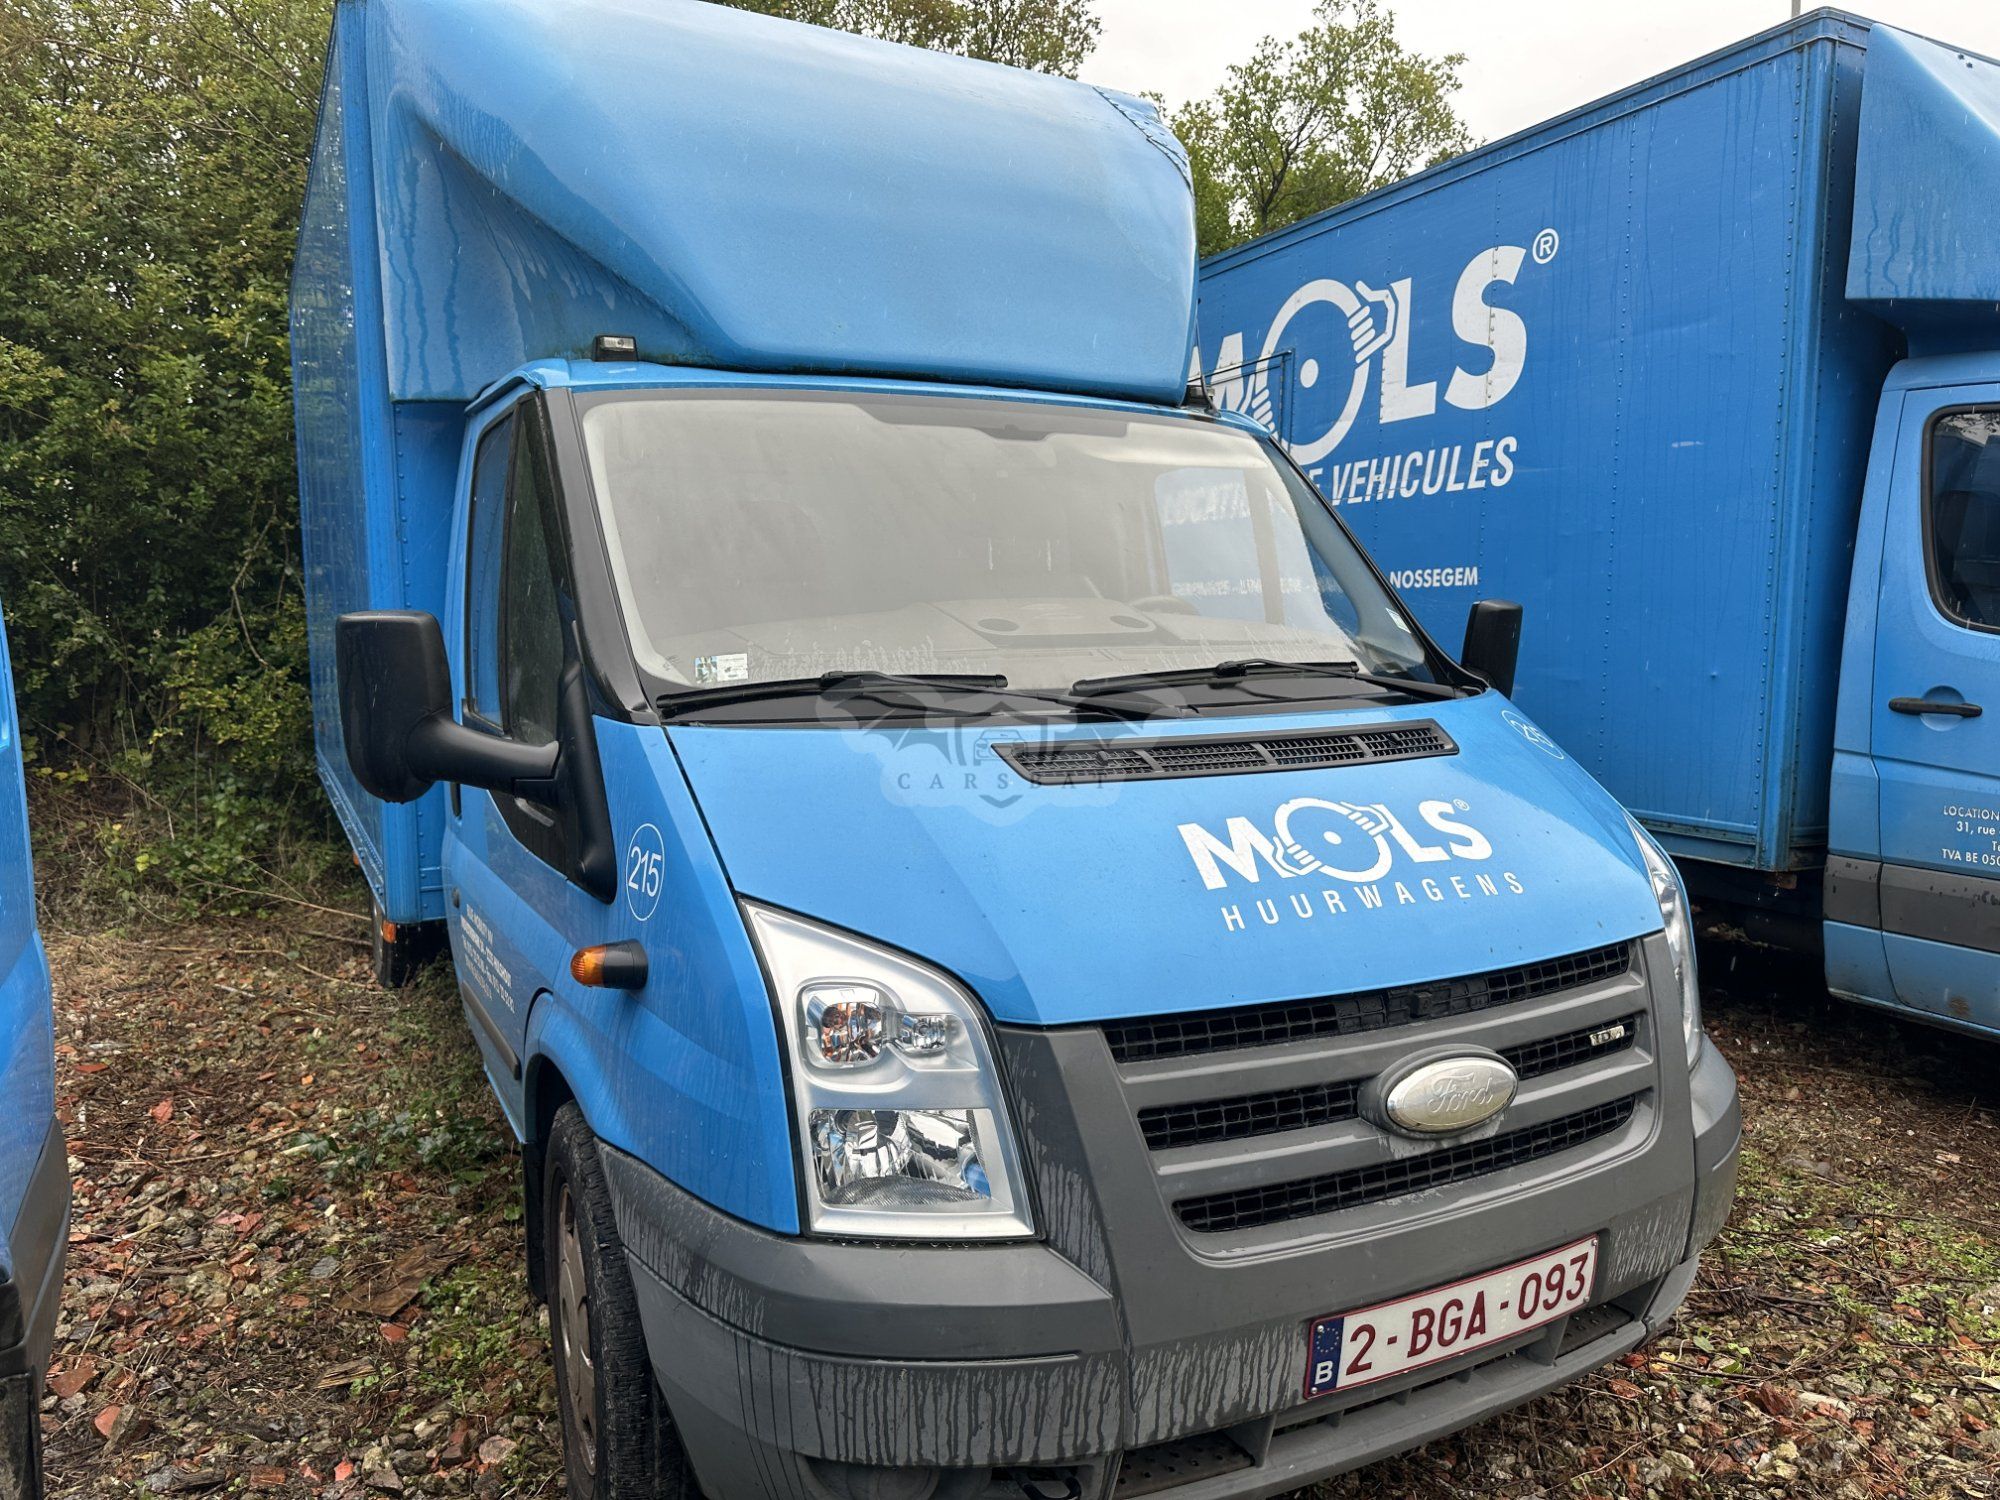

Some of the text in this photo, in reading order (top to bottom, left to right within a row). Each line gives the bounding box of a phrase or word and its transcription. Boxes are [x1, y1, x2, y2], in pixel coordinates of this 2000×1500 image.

[1332, 436, 1518, 505] VEHICULES
[1389, 566, 1479, 589] NOSSEGEM
[1943, 806, 2000, 821] LOCATION
[1956, 821, 1996, 835] 31, rue
[628, 846, 662, 897] 215
[1942, 848, 1962, 861] TVA
[1965, 852, 1978, 863] BE
[1221, 871, 1525, 932] HUURWAGENS
[1427, 1071, 1494, 1113] Ford
[1346, 1252, 1589, 1376] 2-BGA-093
[1314, 1360, 1334, 1385] B
